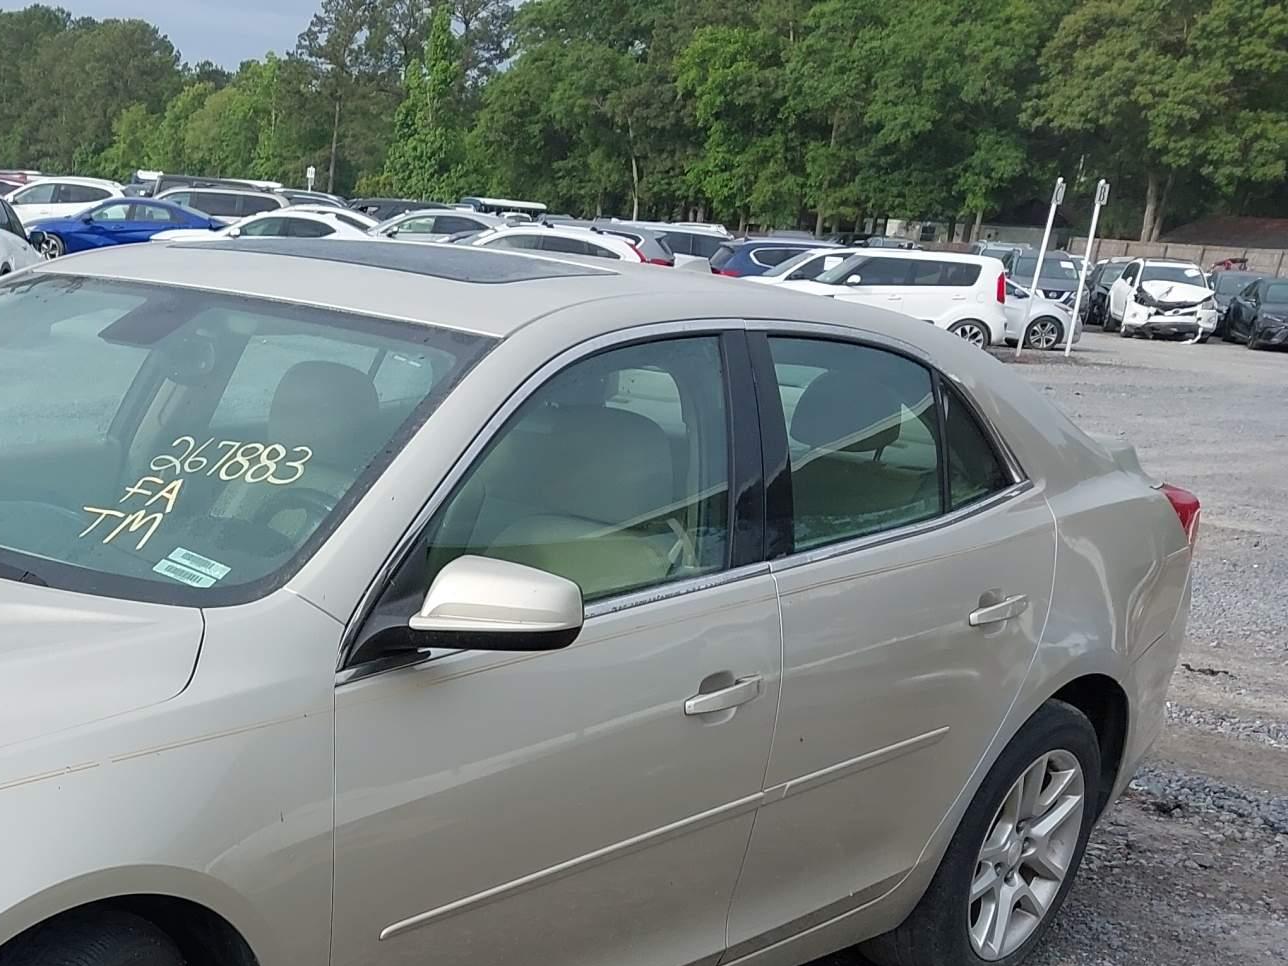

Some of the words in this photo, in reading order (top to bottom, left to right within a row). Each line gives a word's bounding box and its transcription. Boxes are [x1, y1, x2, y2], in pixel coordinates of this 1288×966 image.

[149, 435, 313, 485] 267883
[119, 476, 184, 514] FA
[78, 505, 165, 551] TM
